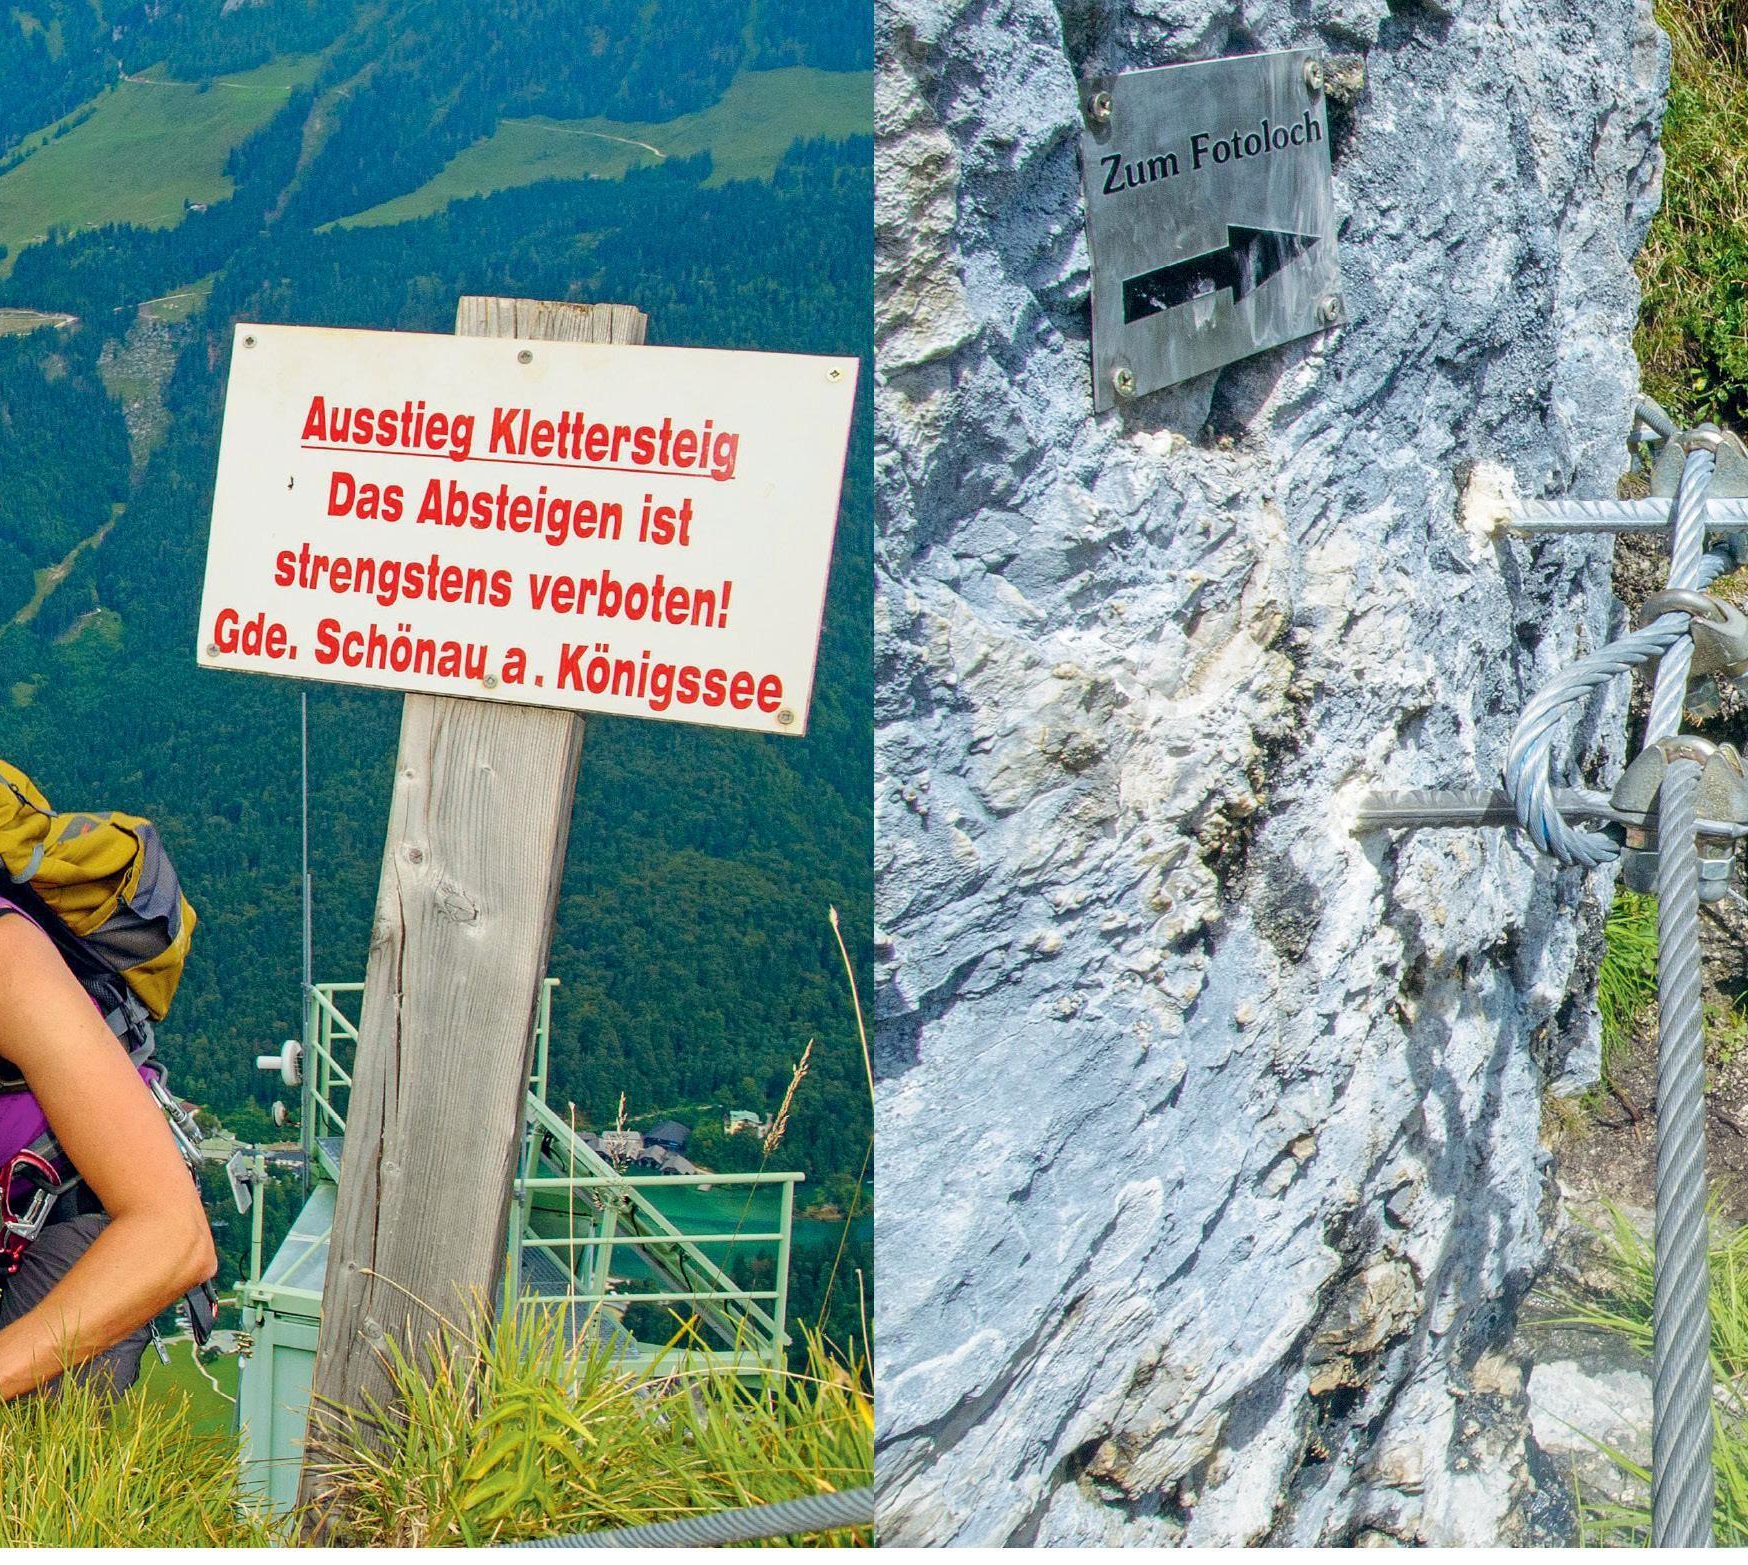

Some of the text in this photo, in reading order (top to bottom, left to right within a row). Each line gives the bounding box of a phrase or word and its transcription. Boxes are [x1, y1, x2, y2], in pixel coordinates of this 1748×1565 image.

[1101, 111, 1321, 194] Zum Fotoloch
[302, 396, 739, 481] Ausstieg Klettersteig
[327, 472, 693, 547] Das Absteigen ist
[274, 543, 732, 628] strengstens verboten!
[214, 608, 297, 659] Gde.
[314, 618, 488, 680] Schönau
[558, 643, 783, 713] Königssee
